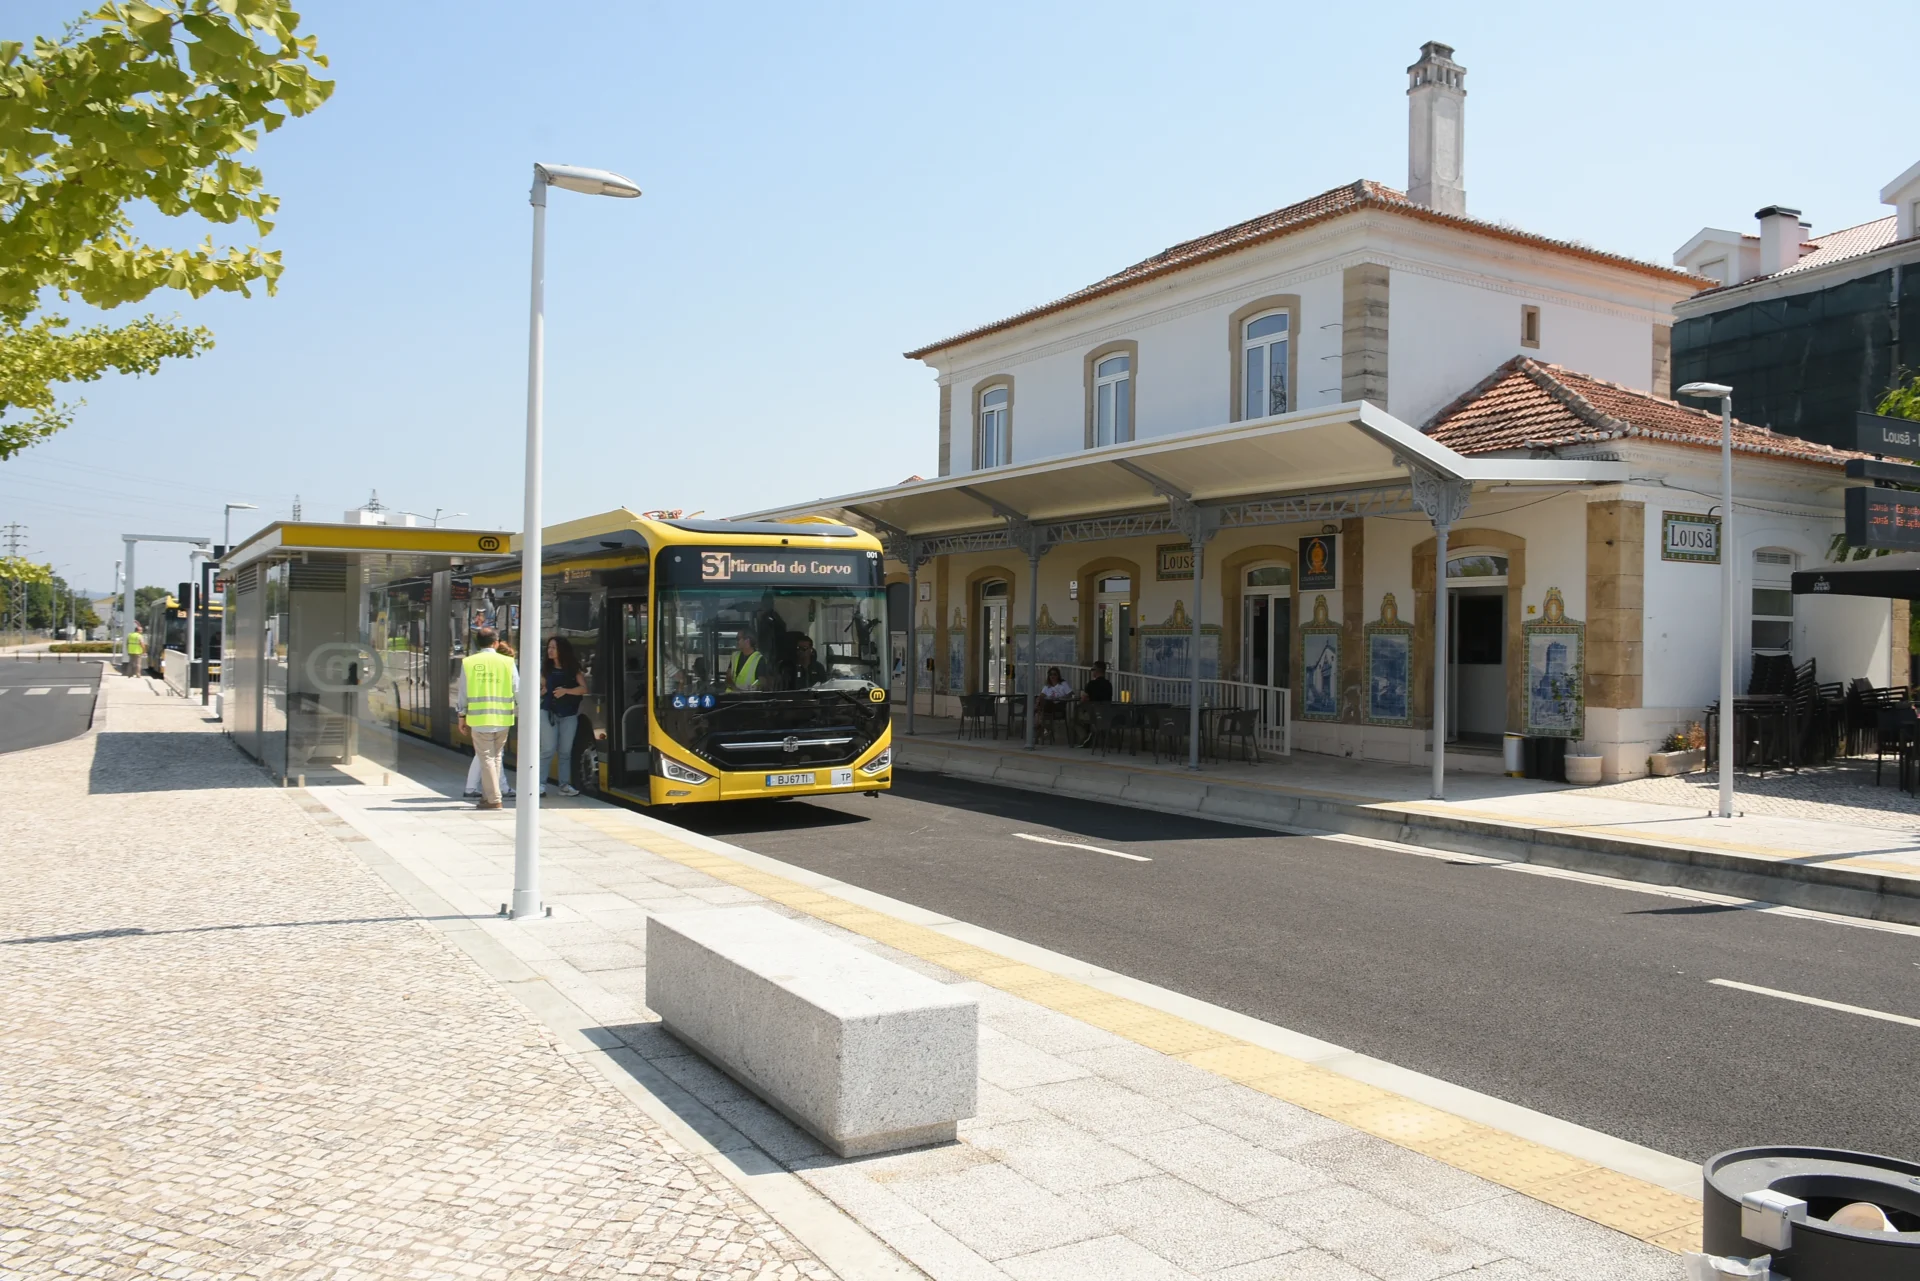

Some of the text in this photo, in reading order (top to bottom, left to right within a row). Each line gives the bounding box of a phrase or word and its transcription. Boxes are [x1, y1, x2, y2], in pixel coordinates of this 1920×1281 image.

[1882, 427, 1911, 446] Lousã
[1671, 524, 1713, 549] Lousã
[866, 551, 878, 559] 001
[702, 553, 852, 578] S1 Miranda do Corvo
[840, 772, 852, 782] TP
